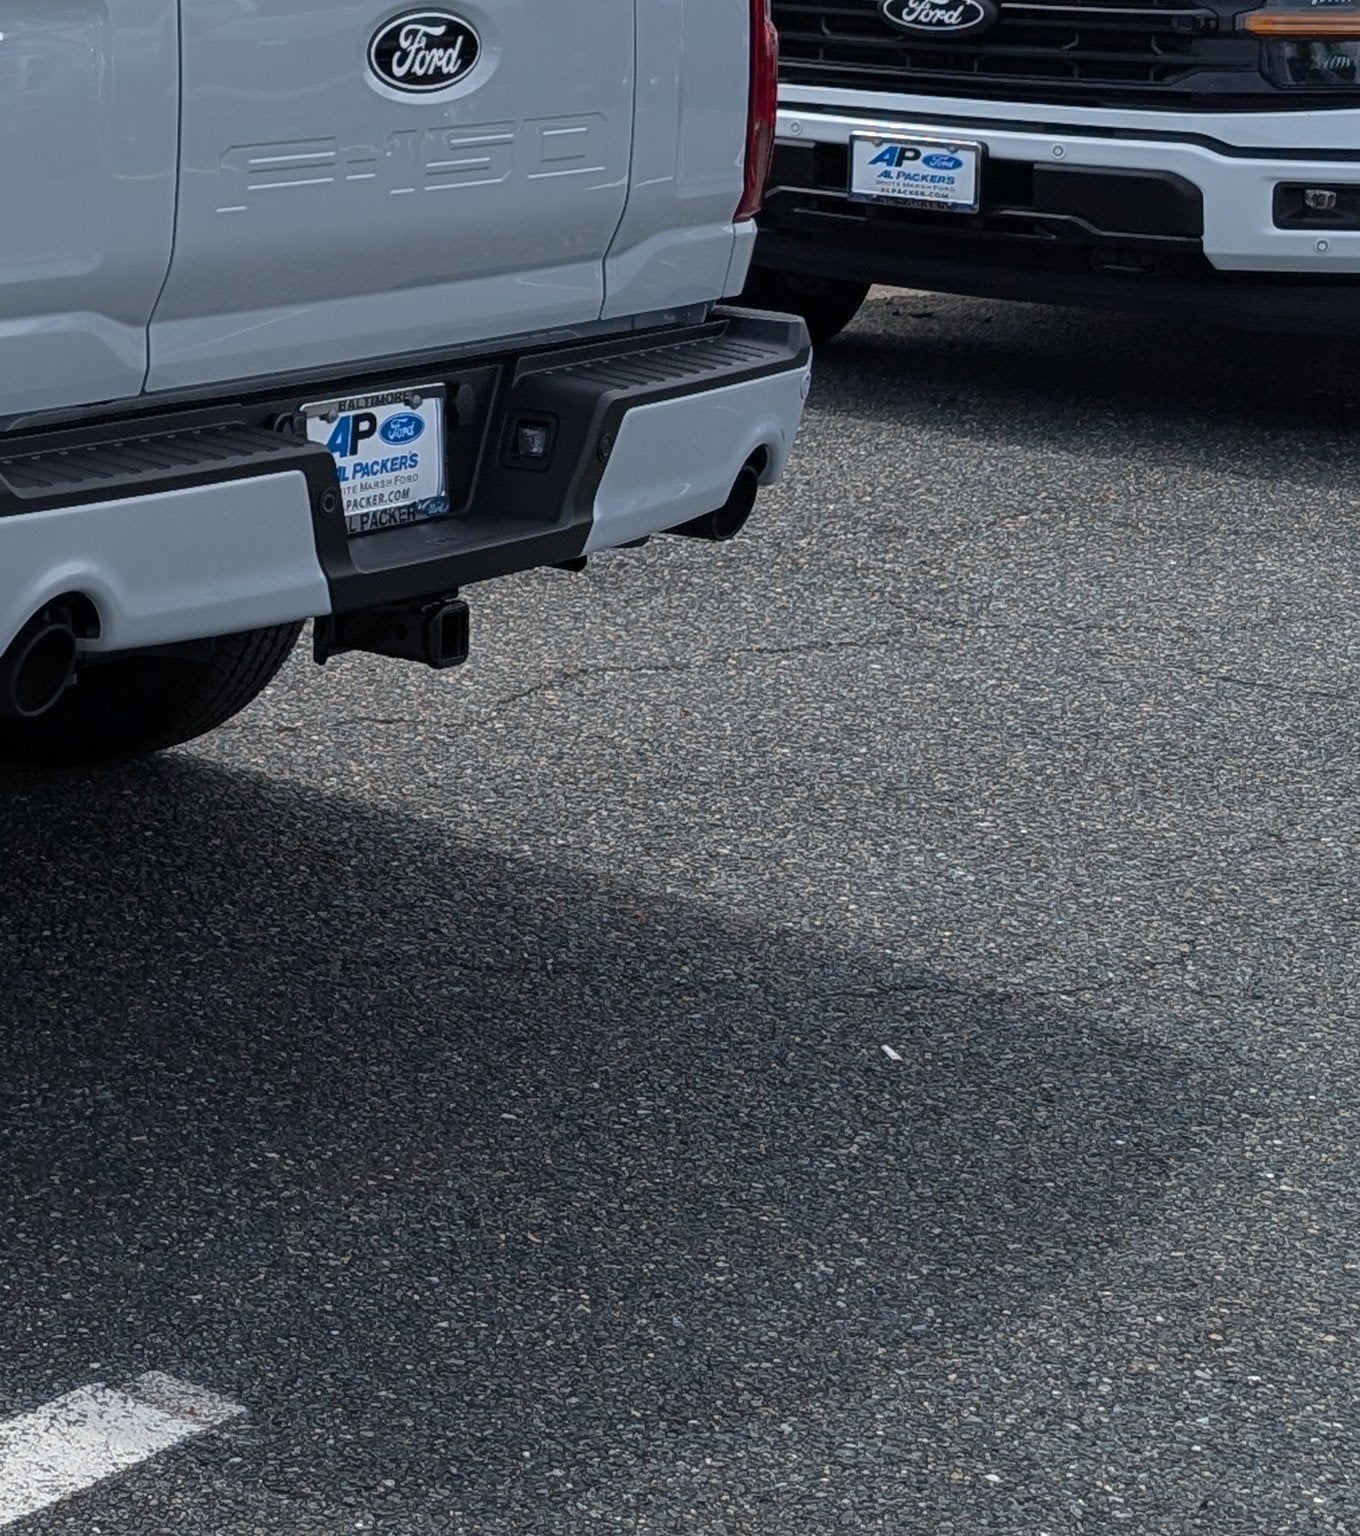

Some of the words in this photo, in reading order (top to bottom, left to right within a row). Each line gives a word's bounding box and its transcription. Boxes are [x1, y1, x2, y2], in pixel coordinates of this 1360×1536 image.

[391, 23, 464, 78] Ford
[216, 111, 608, 212] F-150
[867, 145, 922, 168] AP
[327, 412, 377, 459] AP
[388, 417, 415, 440] Ford
[352, 450, 419, 480] PACKER'S
[393, 473, 419, 486] FORD
[345, 487, 411, 512] PACKER.COM
[360, 506, 417, 531] PACKER
